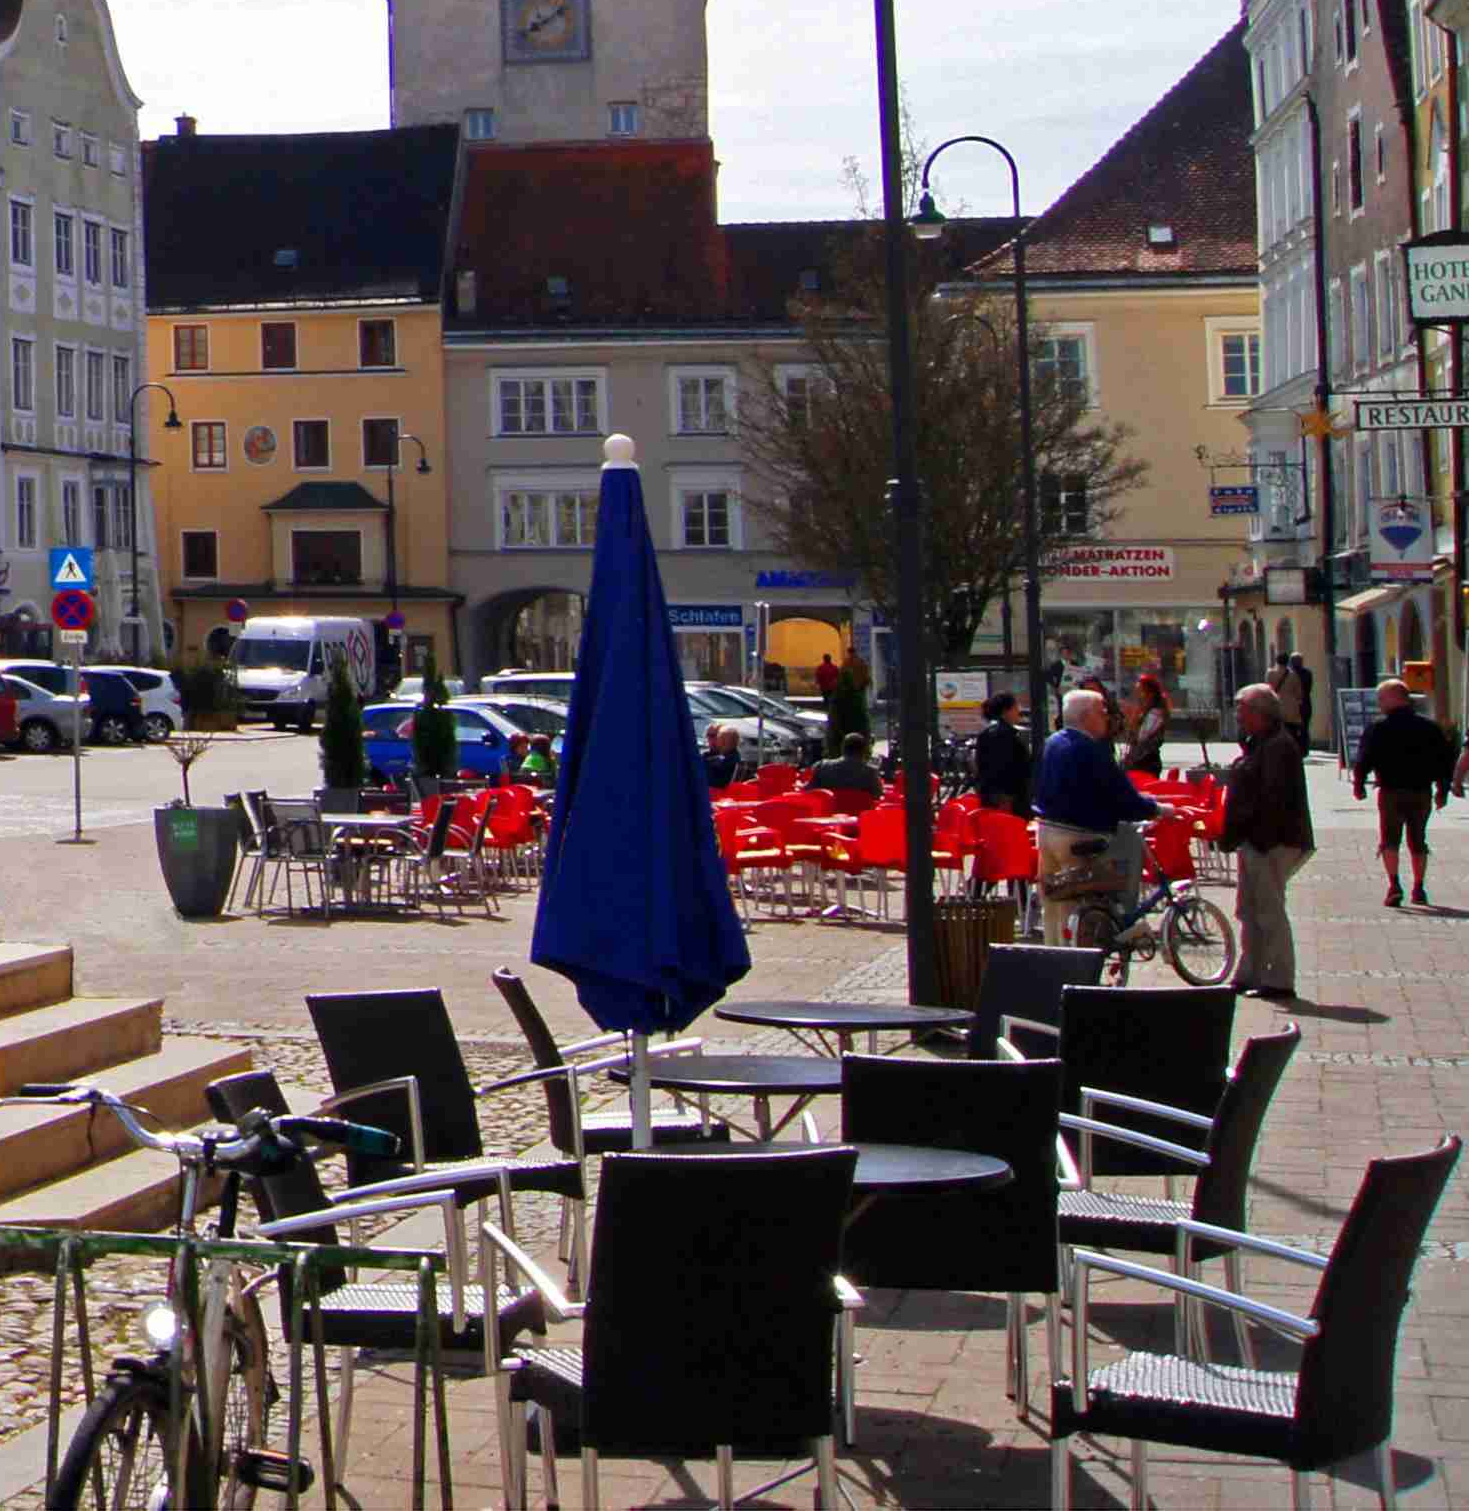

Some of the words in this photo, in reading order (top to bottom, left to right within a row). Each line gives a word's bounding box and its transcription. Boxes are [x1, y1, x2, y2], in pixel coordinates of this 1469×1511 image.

[1420, 282, 1469, 302] GAN
[1368, 404, 1469, 425] RESTAUR
[1037, 565, 1170, 577] ONDER-AKTION
